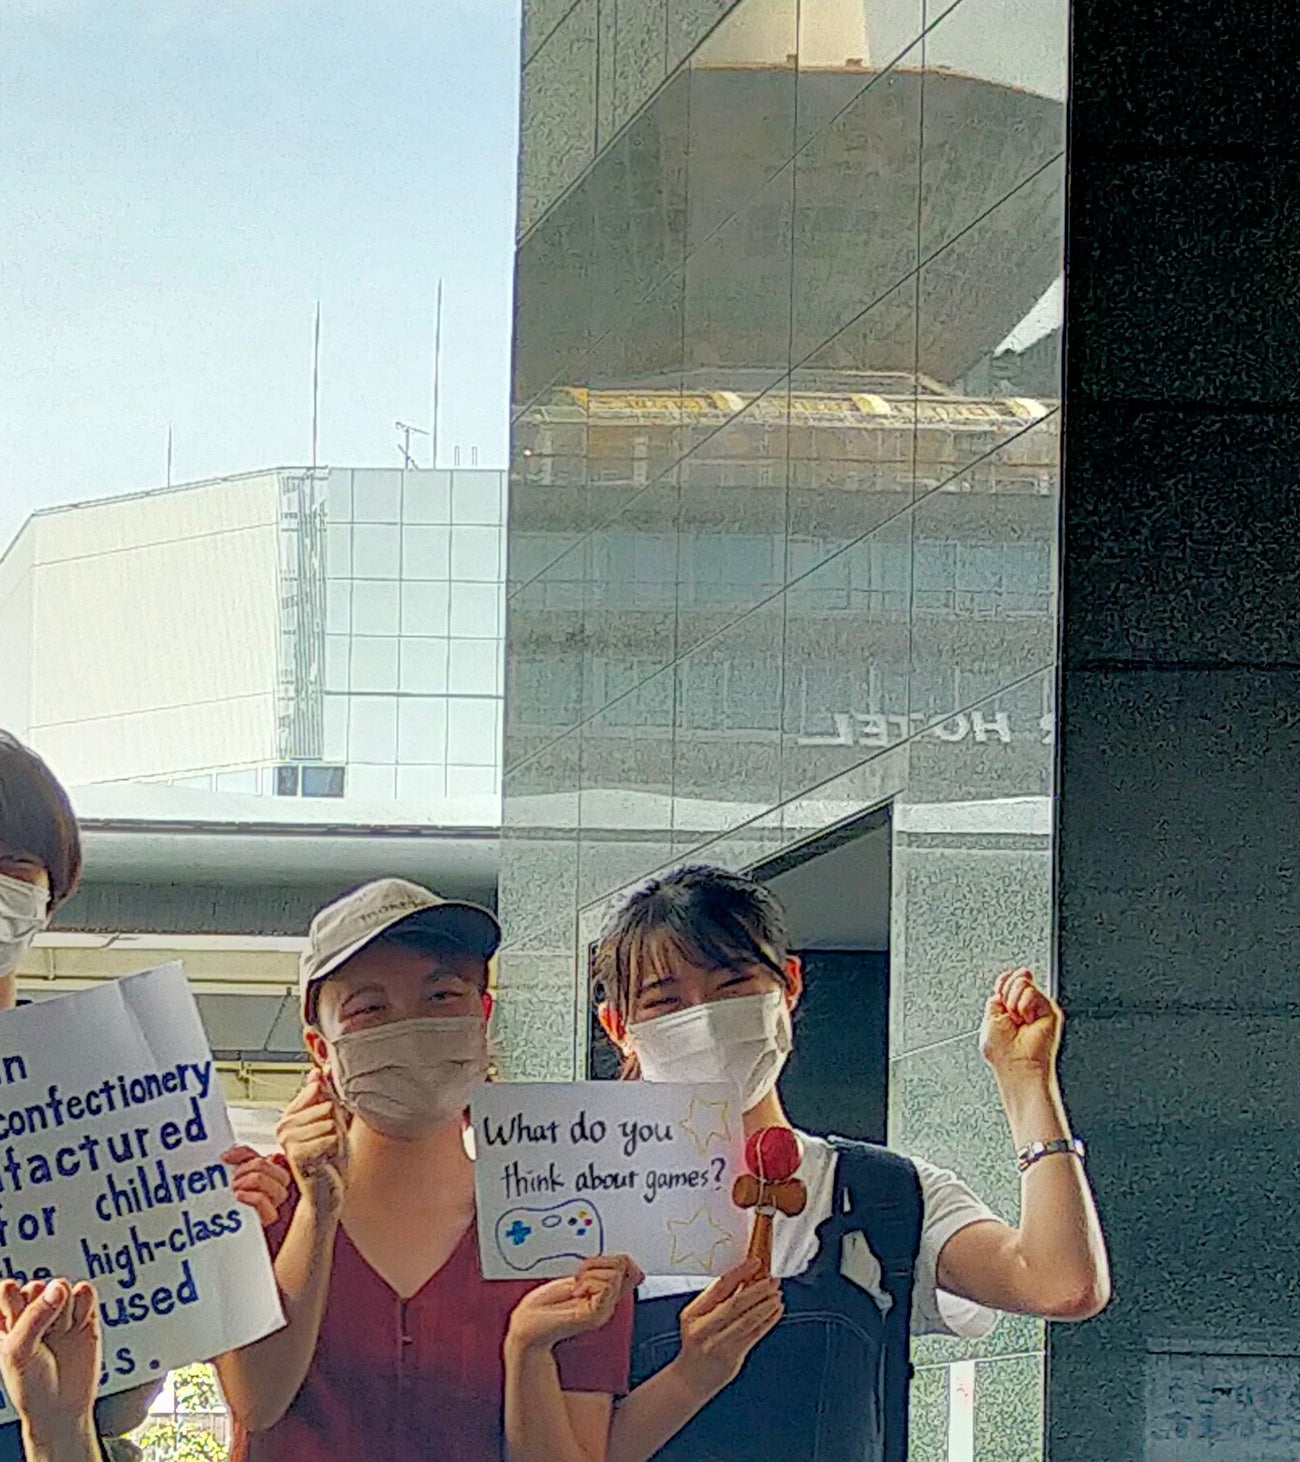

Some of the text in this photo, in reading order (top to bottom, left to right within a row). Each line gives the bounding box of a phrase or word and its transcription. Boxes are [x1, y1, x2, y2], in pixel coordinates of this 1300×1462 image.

[483, 1110, 673, 1157] What do you
[96, 1159, 228, 1221] children
[501, 1157, 726, 1203] think about games?
[81, 1208, 241, 1288] high-class
[100, 1259, 199, 1326] used
